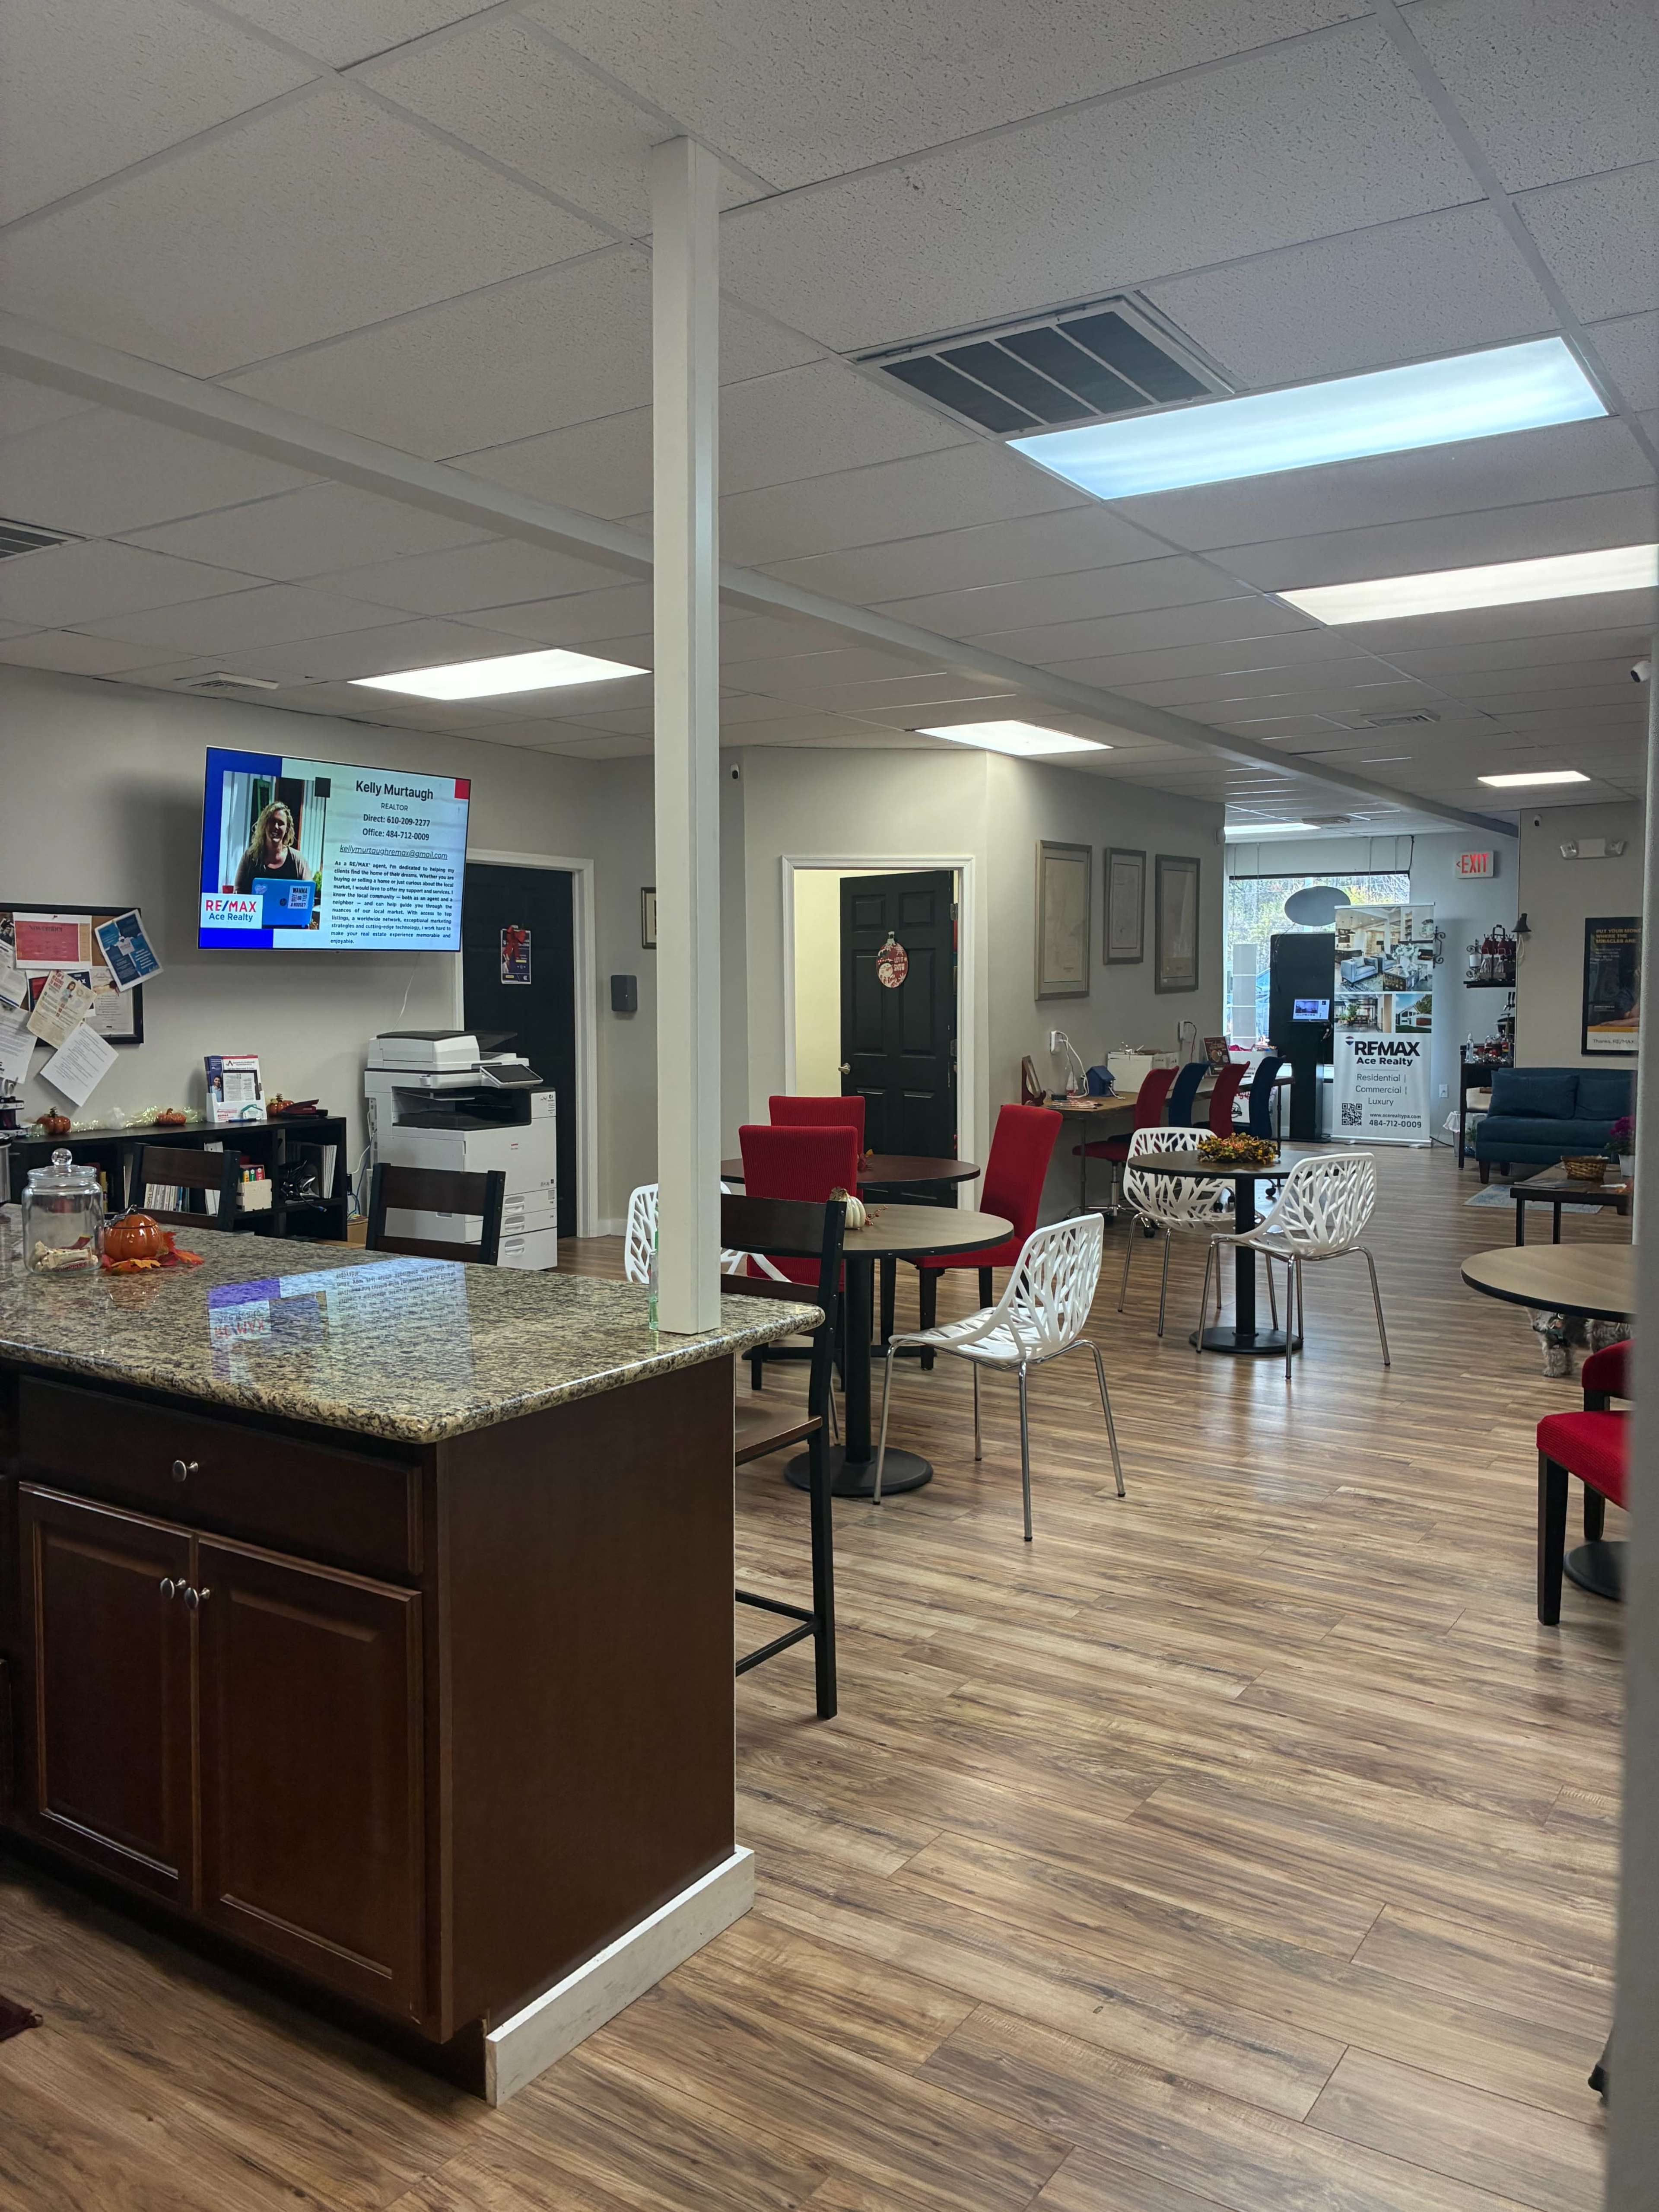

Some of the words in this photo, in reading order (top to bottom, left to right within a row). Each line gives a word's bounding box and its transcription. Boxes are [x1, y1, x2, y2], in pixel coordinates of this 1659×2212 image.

[356, 780, 381, 796] Kelly
[384, 783, 433, 801] Murtaugh
[381, 802, 408, 811] REALTOR
[363, 814, 385, 823] Direct:
[387, 816, 430, 827] 610-209-2277
[362, 828, 385, 837] Office:
[386, 830, 429, 840] 484-712-0009
[340, 844, 448, 860] kellymurtaughremax@gmail.com
[1462, 853, 1488, 873] EXIT
[206, 900, 257, 912] RE/MAX
[227, 913, 253, 922] Realty
[1379, 1057, 1413, 1066] Realty
[1357, 1073, 1400, 1082] Residential
[1355, 1085, 1401, 1093] Commercial
[1368, 1098, 1394, 1106] Luxury
[1369, 1120, 1421, 1128] 484-712-0009
